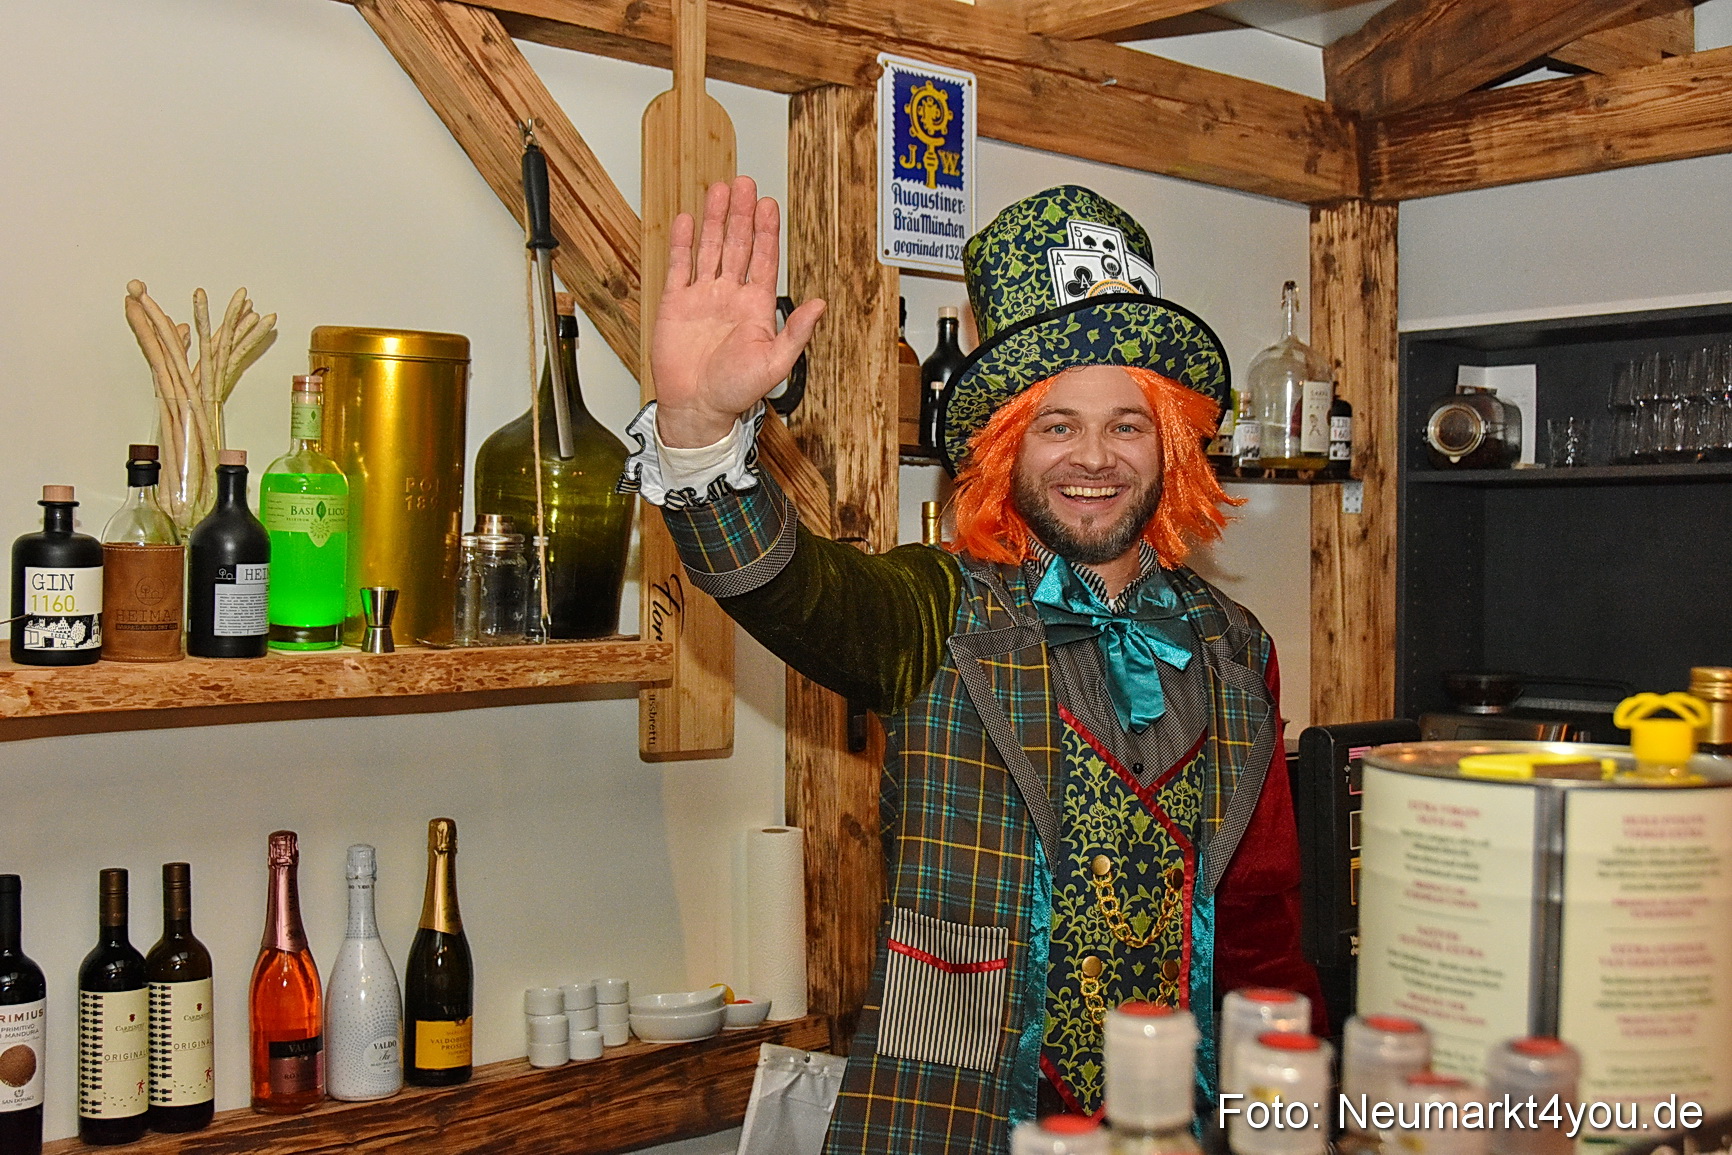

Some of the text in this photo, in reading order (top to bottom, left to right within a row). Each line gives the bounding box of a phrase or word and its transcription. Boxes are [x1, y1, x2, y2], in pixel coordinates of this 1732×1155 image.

[893, 207, 965, 240] Bräu München
[1074, 226, 1083, 237] 5
[893, 238, 964, 261] gegründet 1328
[1055, 252, 1066, 265] A
[1080, 274, 1091, 288] A
[31, 573, 75, 591] GIN
[31, 594, 79, 613] 1160.
[115, 608, 178, 623] HEIMAT
[0, 1023, 35, 1033] PRIMITIVO
[5, 1028, 39, 1039] MANDURIA
[373, 1040, 397, 1050] VALDO
